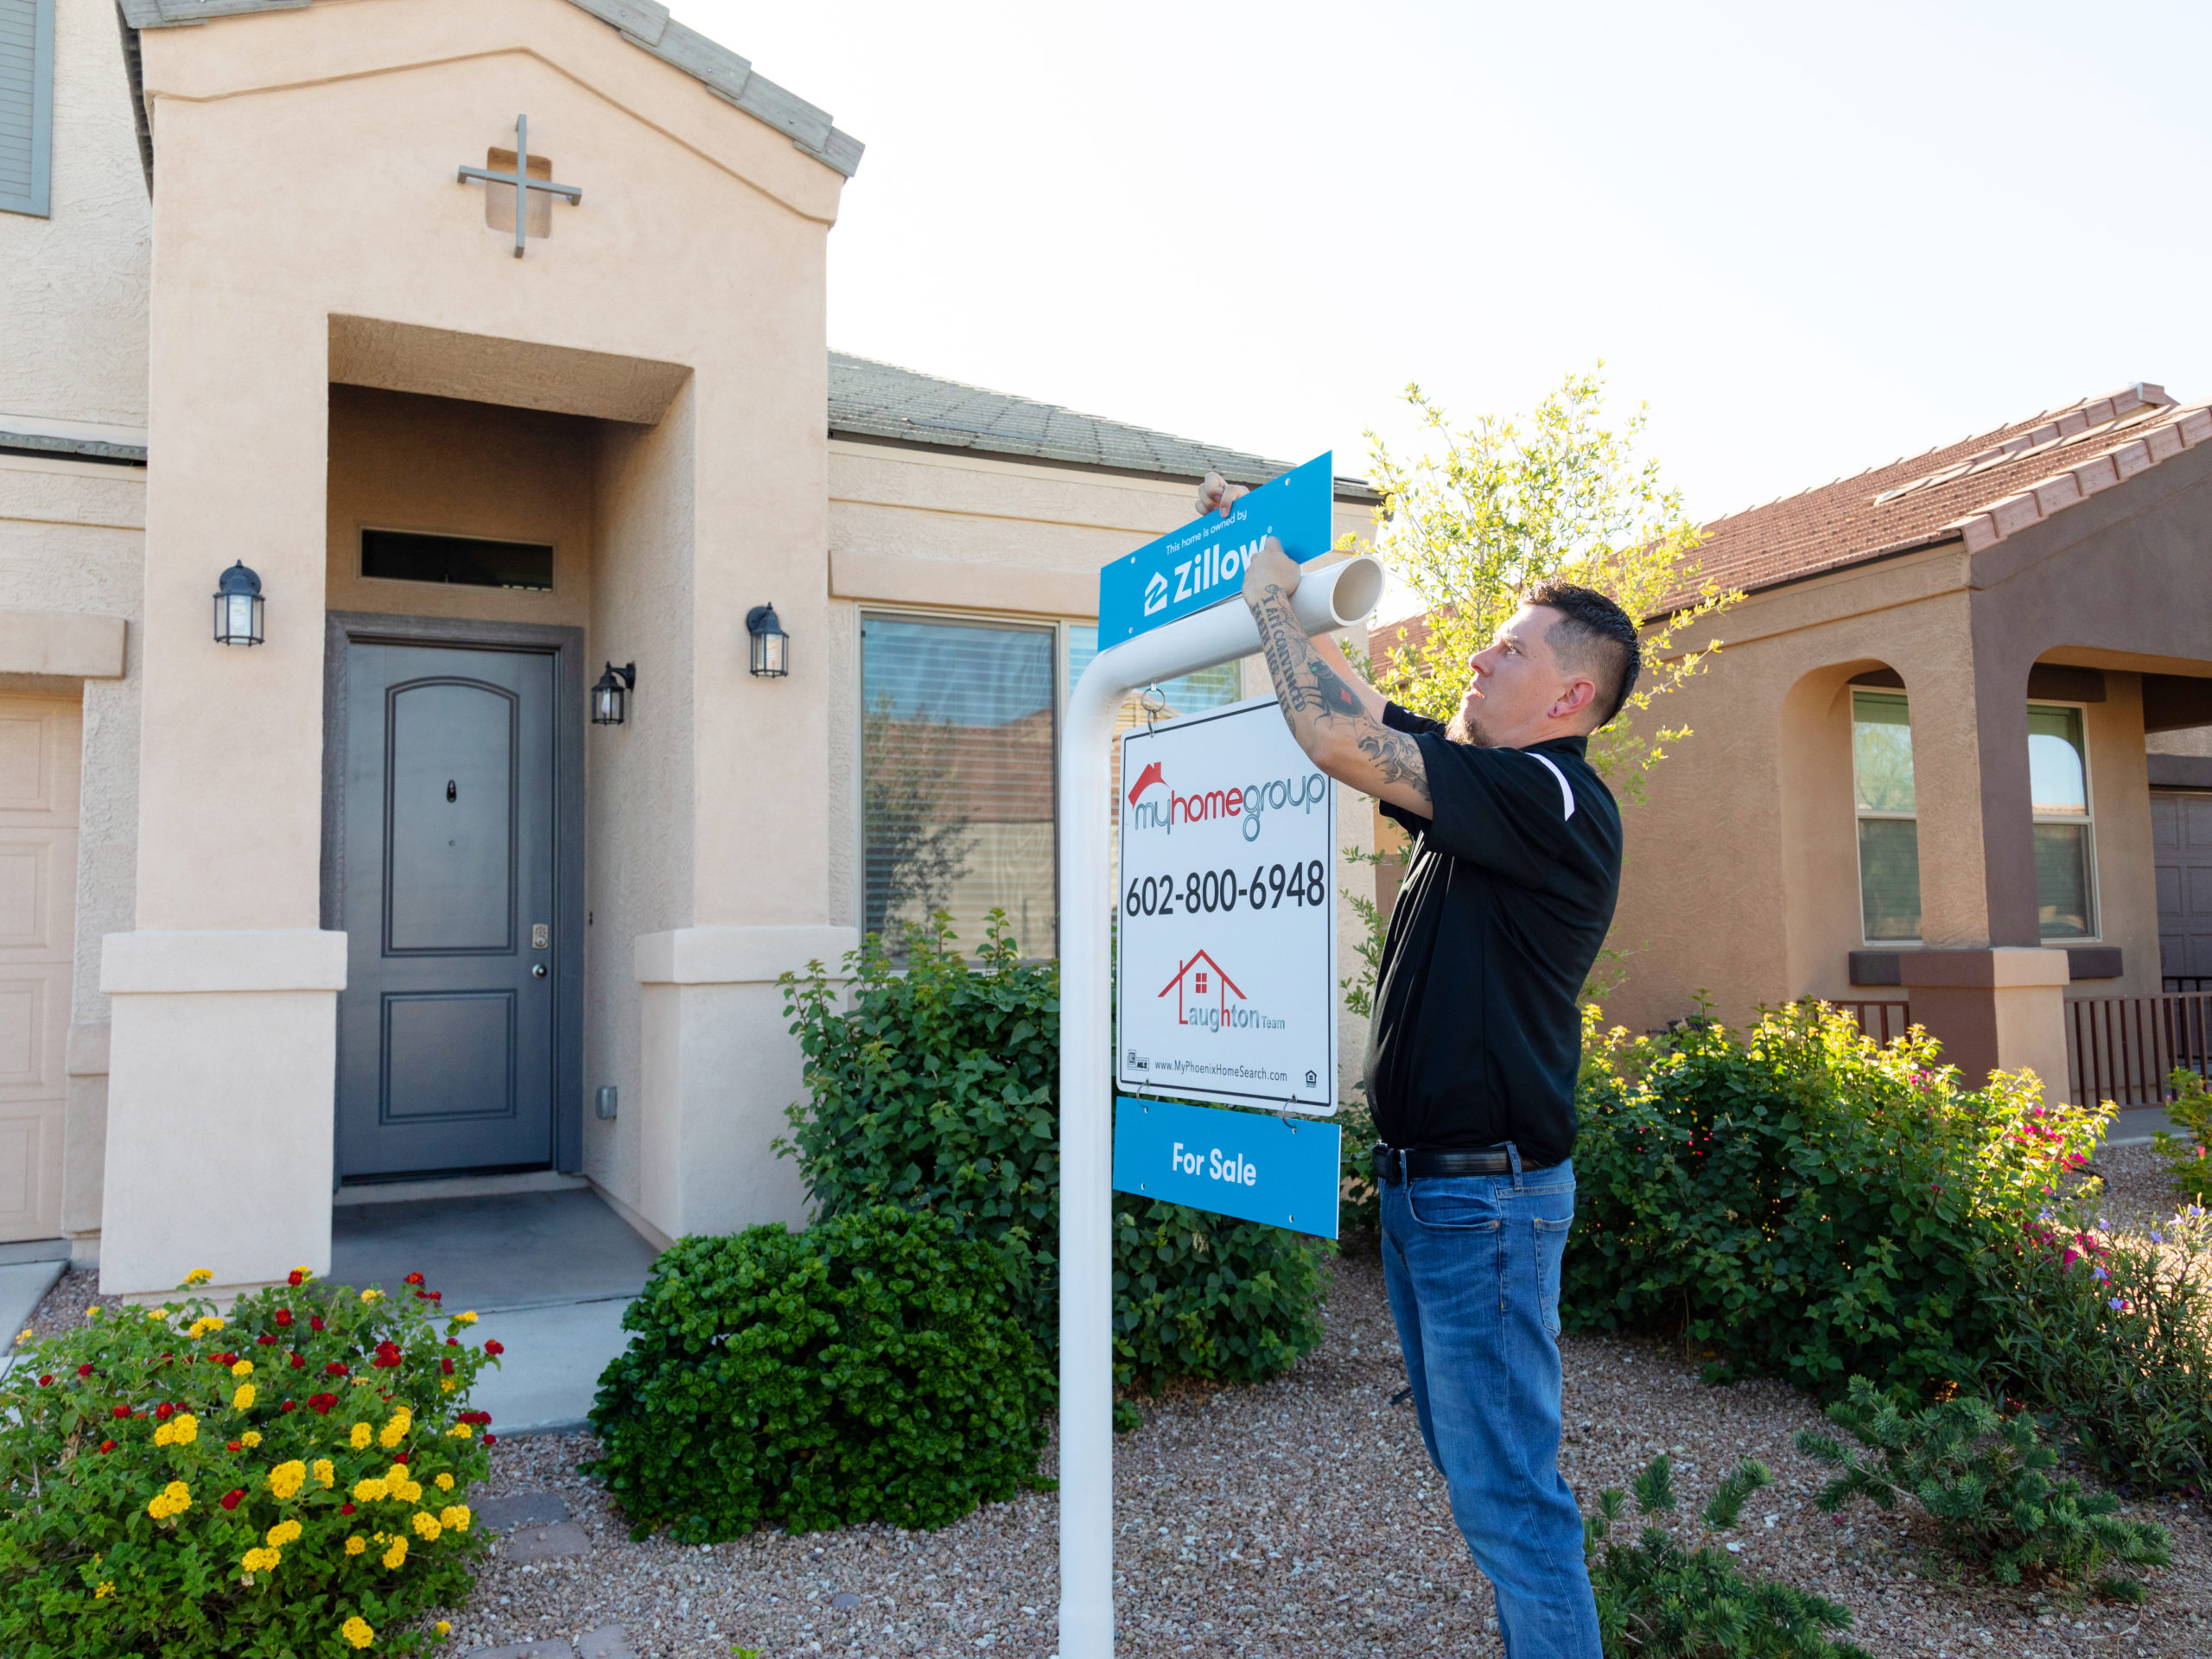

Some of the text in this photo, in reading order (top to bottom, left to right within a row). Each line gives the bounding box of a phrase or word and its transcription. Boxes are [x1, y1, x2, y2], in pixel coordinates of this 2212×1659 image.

[1166, 510, 1248, 556] This home is owned by
[1135, 773, 1325, 842] myhomegroup
[1126, 860, 1325, 917] 602-800-6948
[1179, 990, 1286, 1033] Laughton Team
[1154, 1060, 1287, 1082] www.MyPhoenixHomeSearch.com
[1173, 1141, 1256, 1186] For Sale
